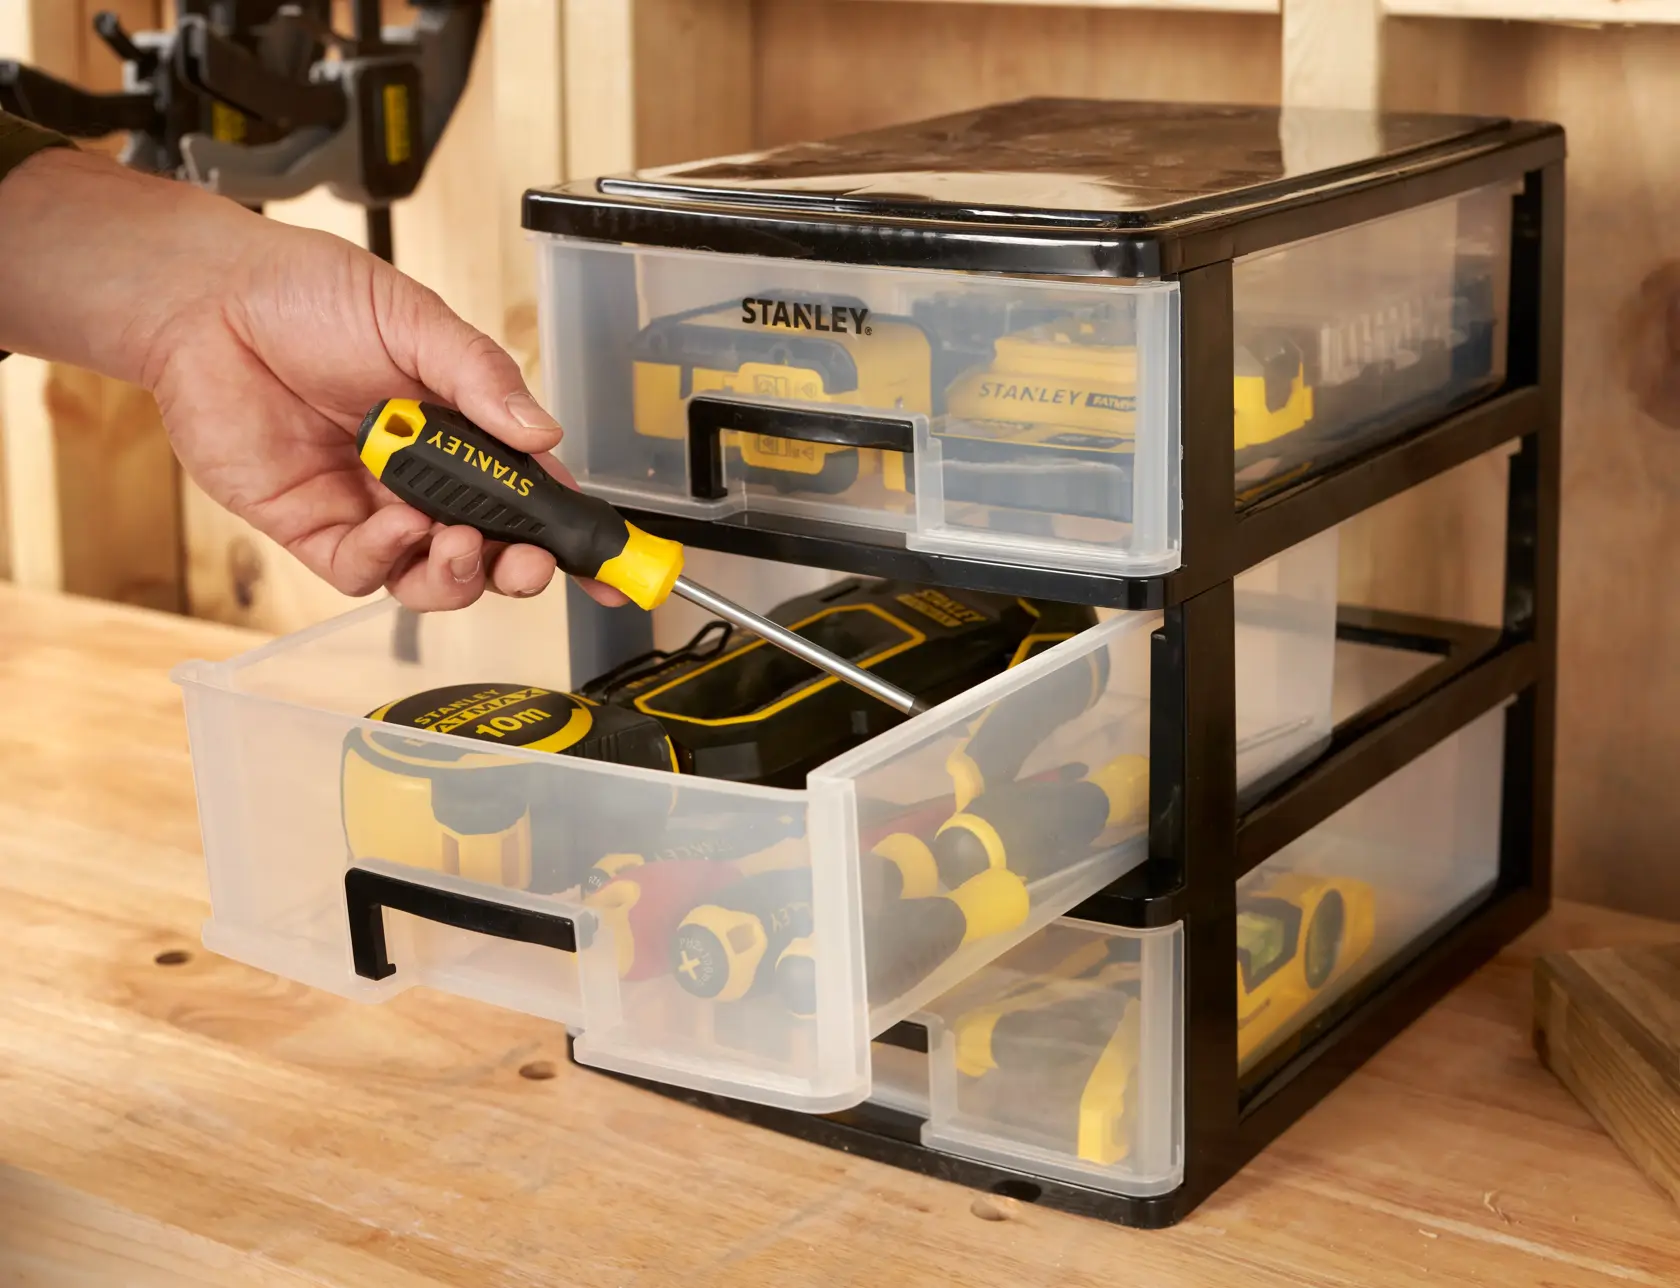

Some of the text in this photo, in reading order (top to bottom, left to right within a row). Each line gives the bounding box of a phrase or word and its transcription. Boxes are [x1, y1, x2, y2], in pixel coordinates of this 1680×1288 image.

[979, 381, 1084, 407] STANLEY
[426, 430, 535, 497] STANLEY
[414, 688, 500, 725] STANLEY
[428, 688, 546, 734] ATMAX
[475, 707, 552, 738] 10m
